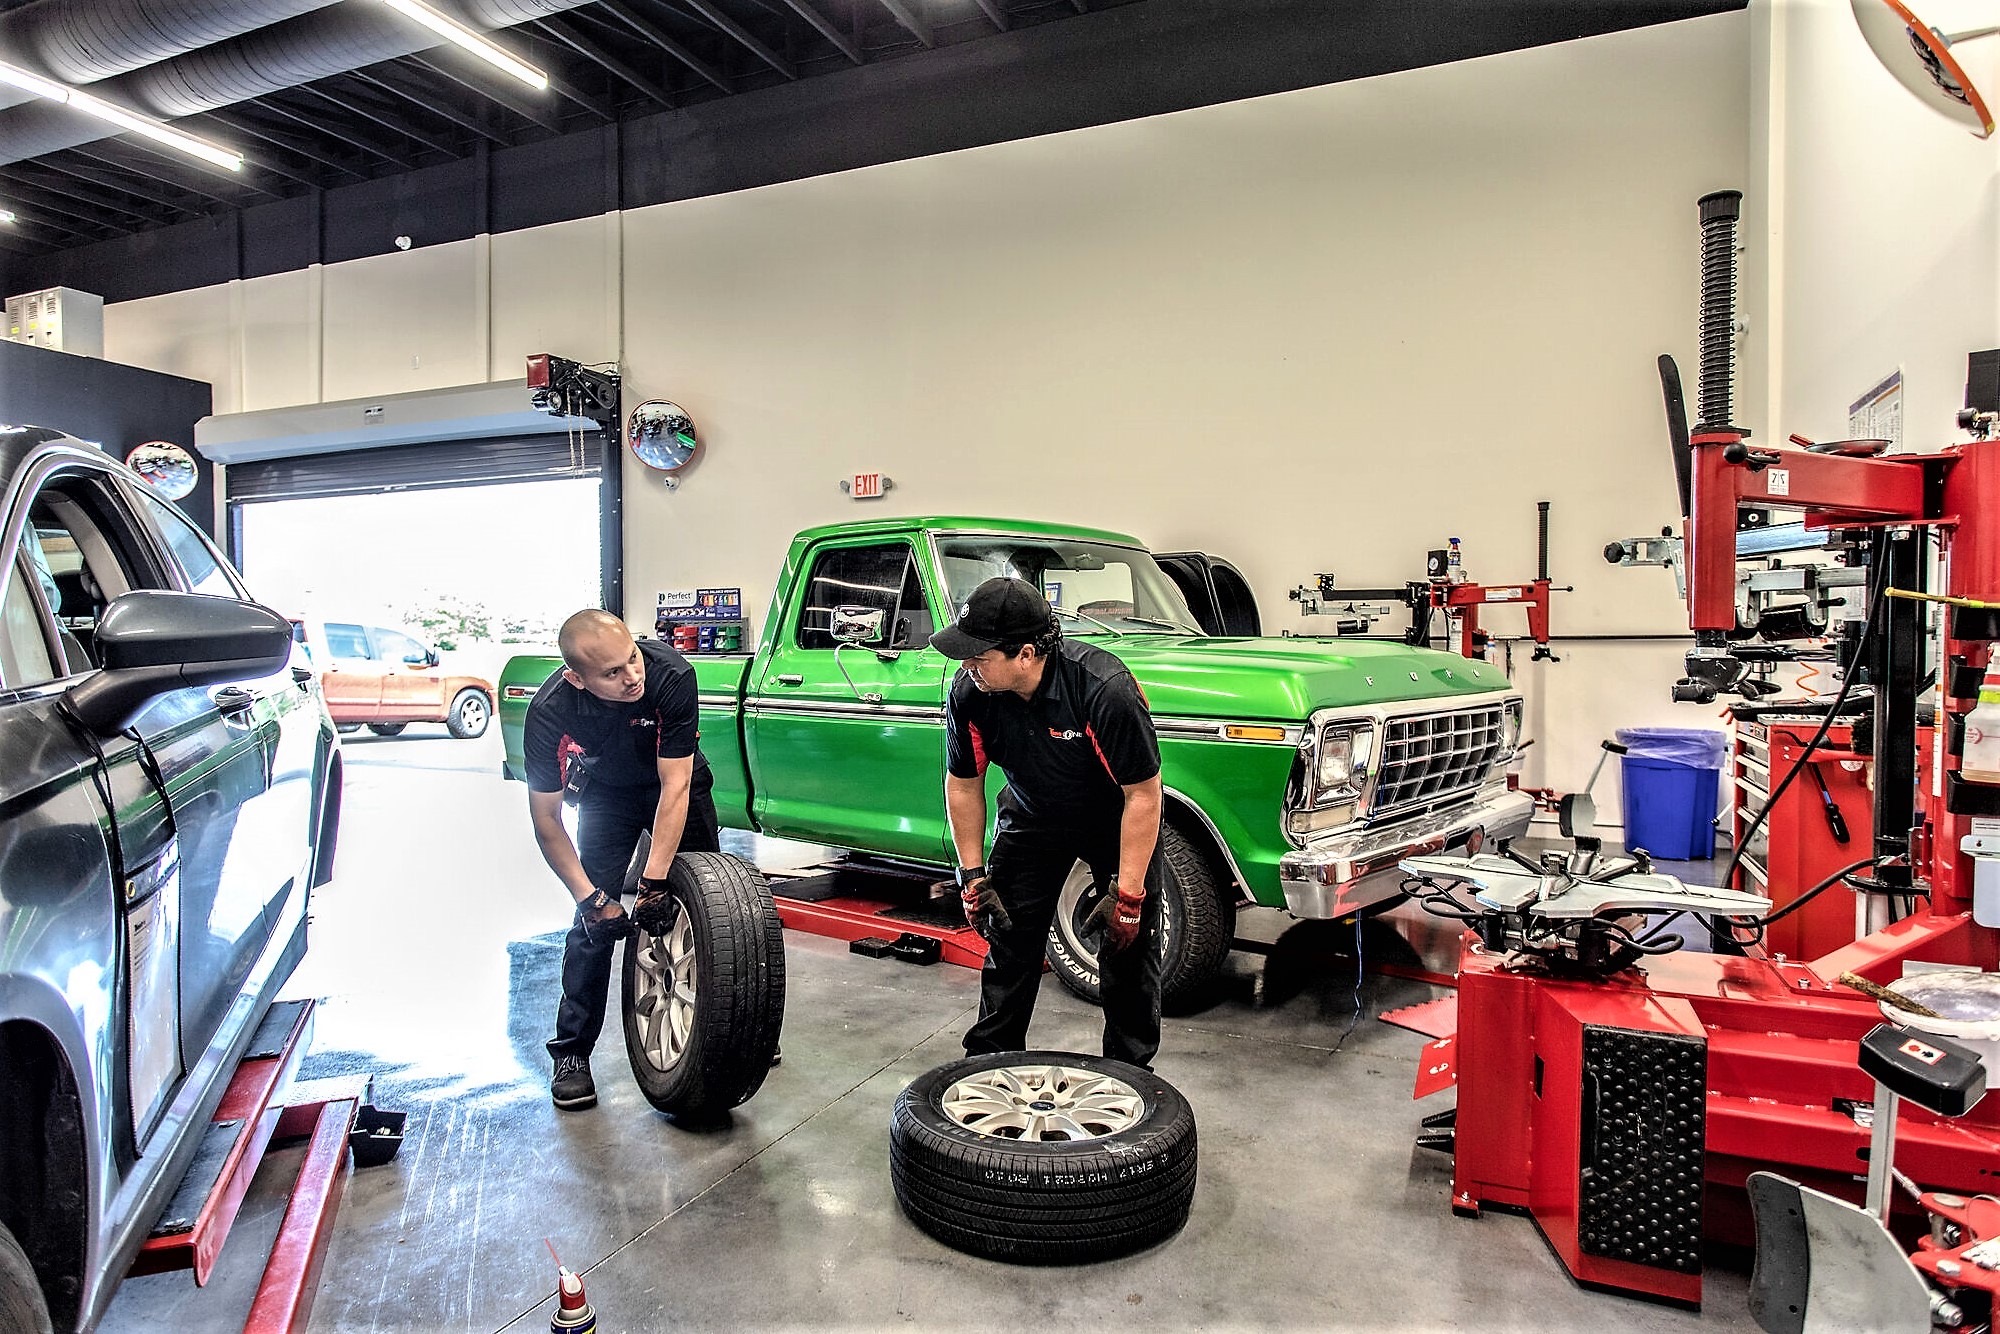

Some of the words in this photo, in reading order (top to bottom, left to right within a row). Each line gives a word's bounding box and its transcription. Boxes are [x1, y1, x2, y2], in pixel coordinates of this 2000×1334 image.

[855, 473, 879, 496] EXIT
[667, 592, 692, 600] Perfect
[1049, 926, 1100, 986] AVENGE
